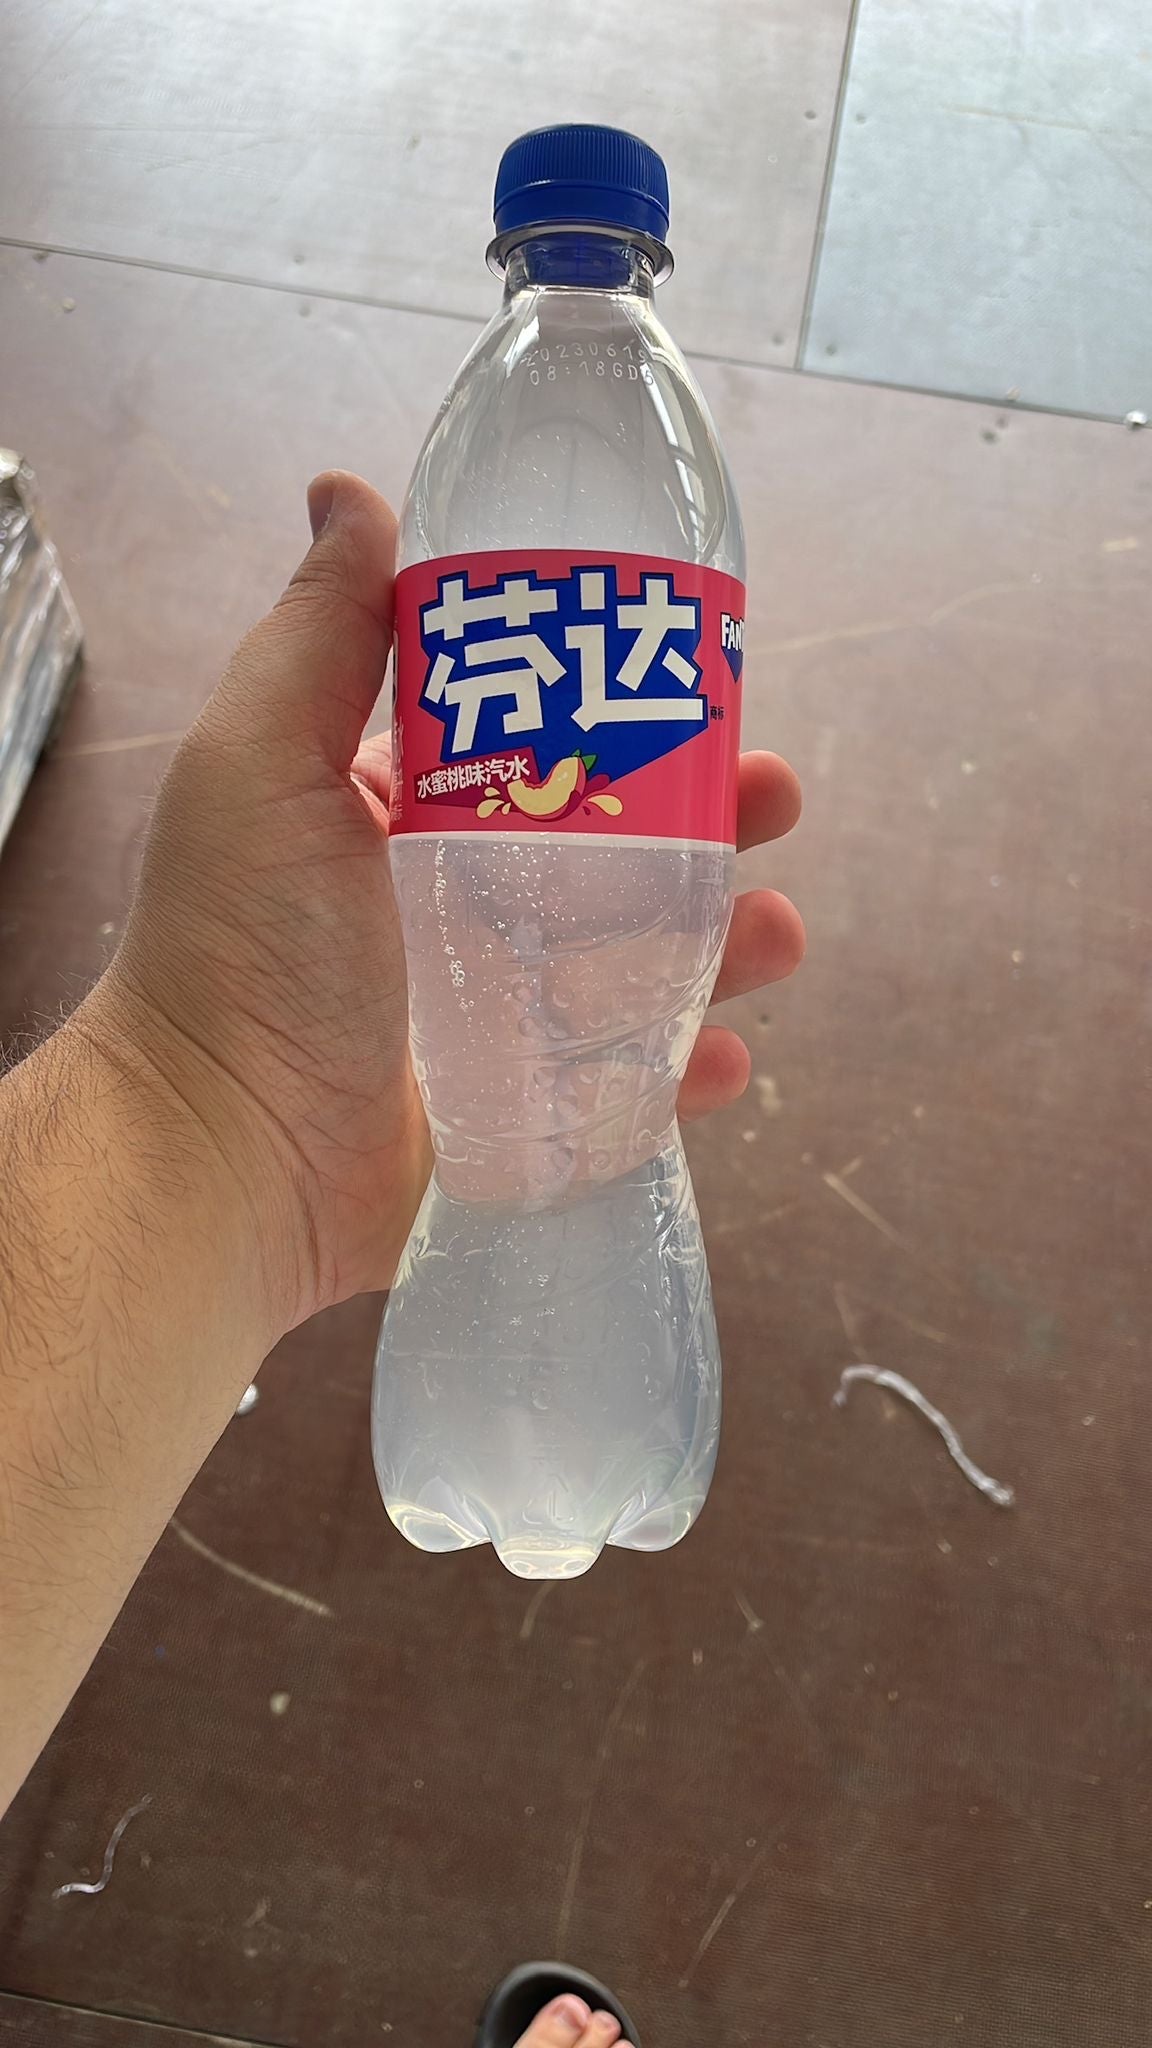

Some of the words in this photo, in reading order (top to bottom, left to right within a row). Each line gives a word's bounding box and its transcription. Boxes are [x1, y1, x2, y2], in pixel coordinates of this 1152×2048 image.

[423, 572, 704, 754] 芬达
[417, 755, 530, 799] 水蜜桃味汽水
